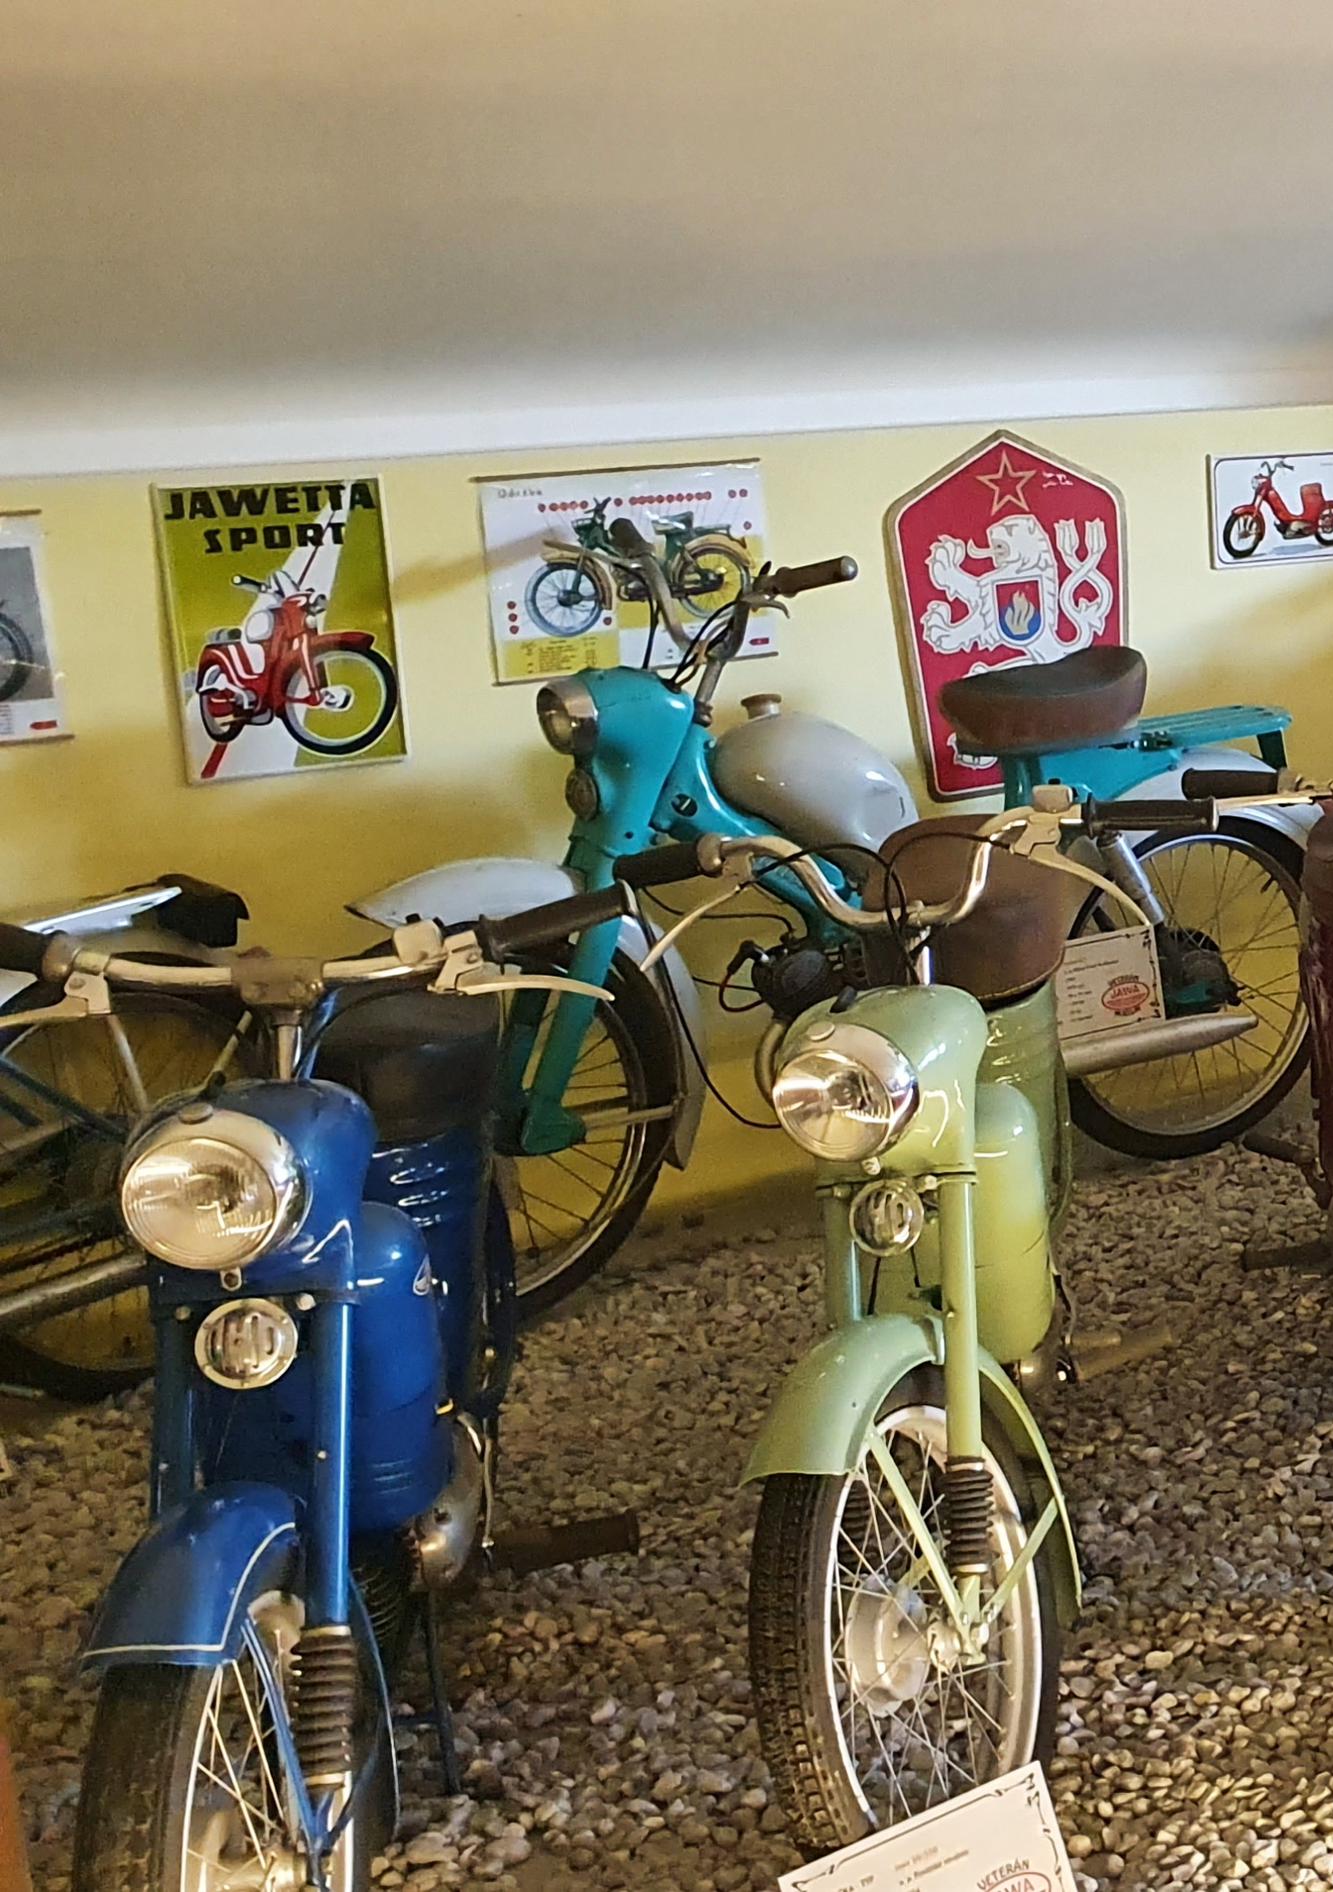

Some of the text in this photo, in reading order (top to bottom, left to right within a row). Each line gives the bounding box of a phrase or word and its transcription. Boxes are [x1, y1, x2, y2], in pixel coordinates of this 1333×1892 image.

[164, 483, 375, 521] JAWETTA
[204, 522, 346, 554] SPORT
[976, 1857, 1030, 1890] VETERÁN
